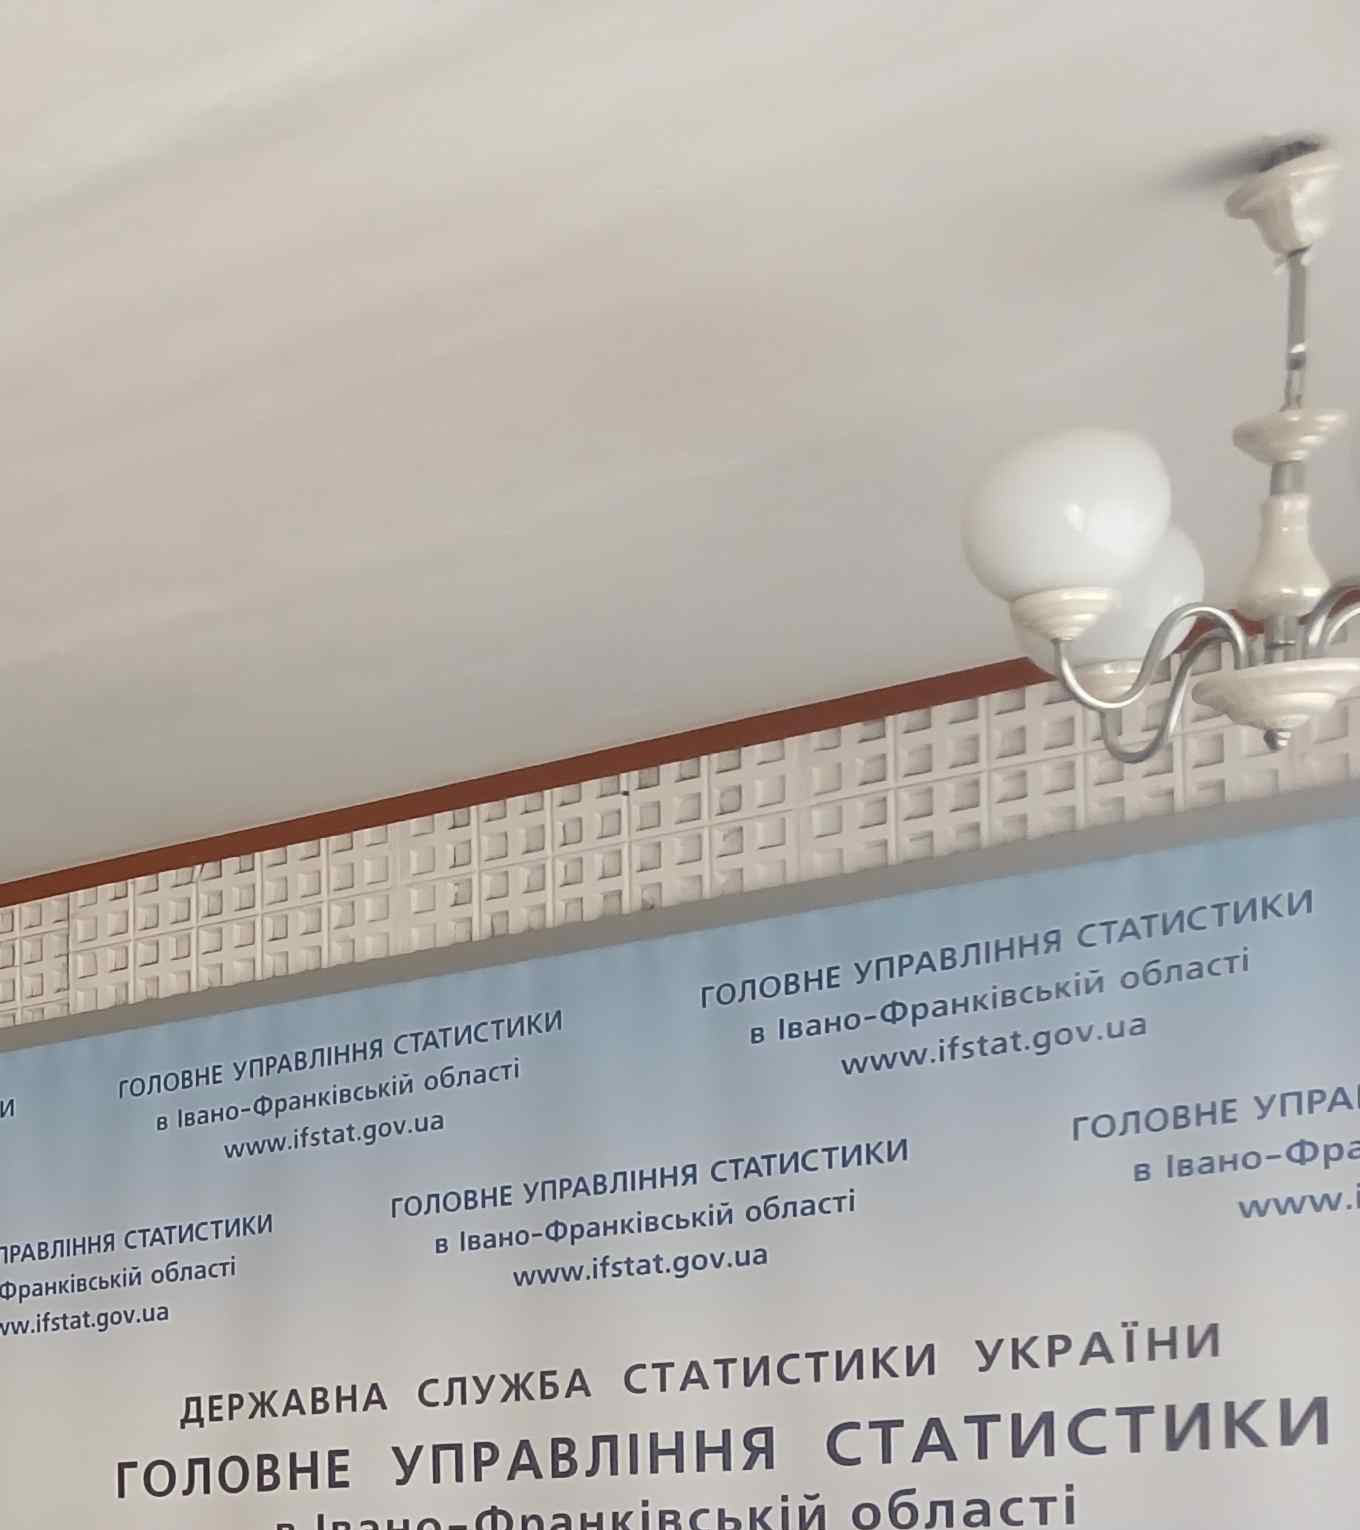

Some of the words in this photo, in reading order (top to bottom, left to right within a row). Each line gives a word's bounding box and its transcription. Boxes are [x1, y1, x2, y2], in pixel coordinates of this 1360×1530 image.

[702, 966, 840, 1008] ГОЛОВНЕ
[854, 929, 1061, 989] УПРАВЛІННЯ
[1077, 890, 1312, 951] СТАТИСТИКИ
[751, 1027, 764, 1044] в
[779, 970, 1104, 1045] Івано-Франківській
[1120, 946, 1248, 989] області
[120, 1065, 222, 1099] ГОЛОВНЕ
[233, 1039, 382, 1084] УПРАВЛІННЯ
[394, 1010, 561, 1056] СТАТИСТИКИ
[841, 1013, 1146, 1075] www.ifstat.gov.ua
[157, 1116, 168, 1131] в
[178, 1074, 413, 1129] Івано-Франківській
[424, 1057, 519, 1090] області
[1073, 1098, 1237, 1141] ГОЛОВНЕ
[1254, 1084, 1360, 1120] УПРА
[224, 1112, 443, 1158] www.ifstat.gov.ua
[392, 1185, 512, 1218] ГОЛОВНЕ
[523, 1164, 697, 1204] УПРАВЛІННЯ
[711, 1138, 907, 1182] СТАТИСТИКИ
[1134, 1163, 1151, 1182] в
[124, 1214, 272, 1249] СТАТИСТИКИ
[436, 1238, 448, 1254] в
[461, 1202, 733, 1252] Івано-Франківській
[746, 1188, 854, 1222] області
[151, 1256, 235, 1284] області
[513, 1248, 767, 1287] www.ifstat.gov.ua
[180, 1382, 388, 1429] ДЕРЖАВНА
[418, 1368, 592, 1407] СЛУЖБА
[624, 1343, 935, 1394] СТАТИСТИКИ
[974, 1321, 1219, 1372] УКРАЇНИ
[117, 1449, 350, 1499] ГОЛОВНЕ
[391, 1426, 774, 1486] УПРАВЛІННЯ
[826, 1396, 1328, 1466] СТАТИСТИКИ
[852, 1483, 1075, 1530] області
